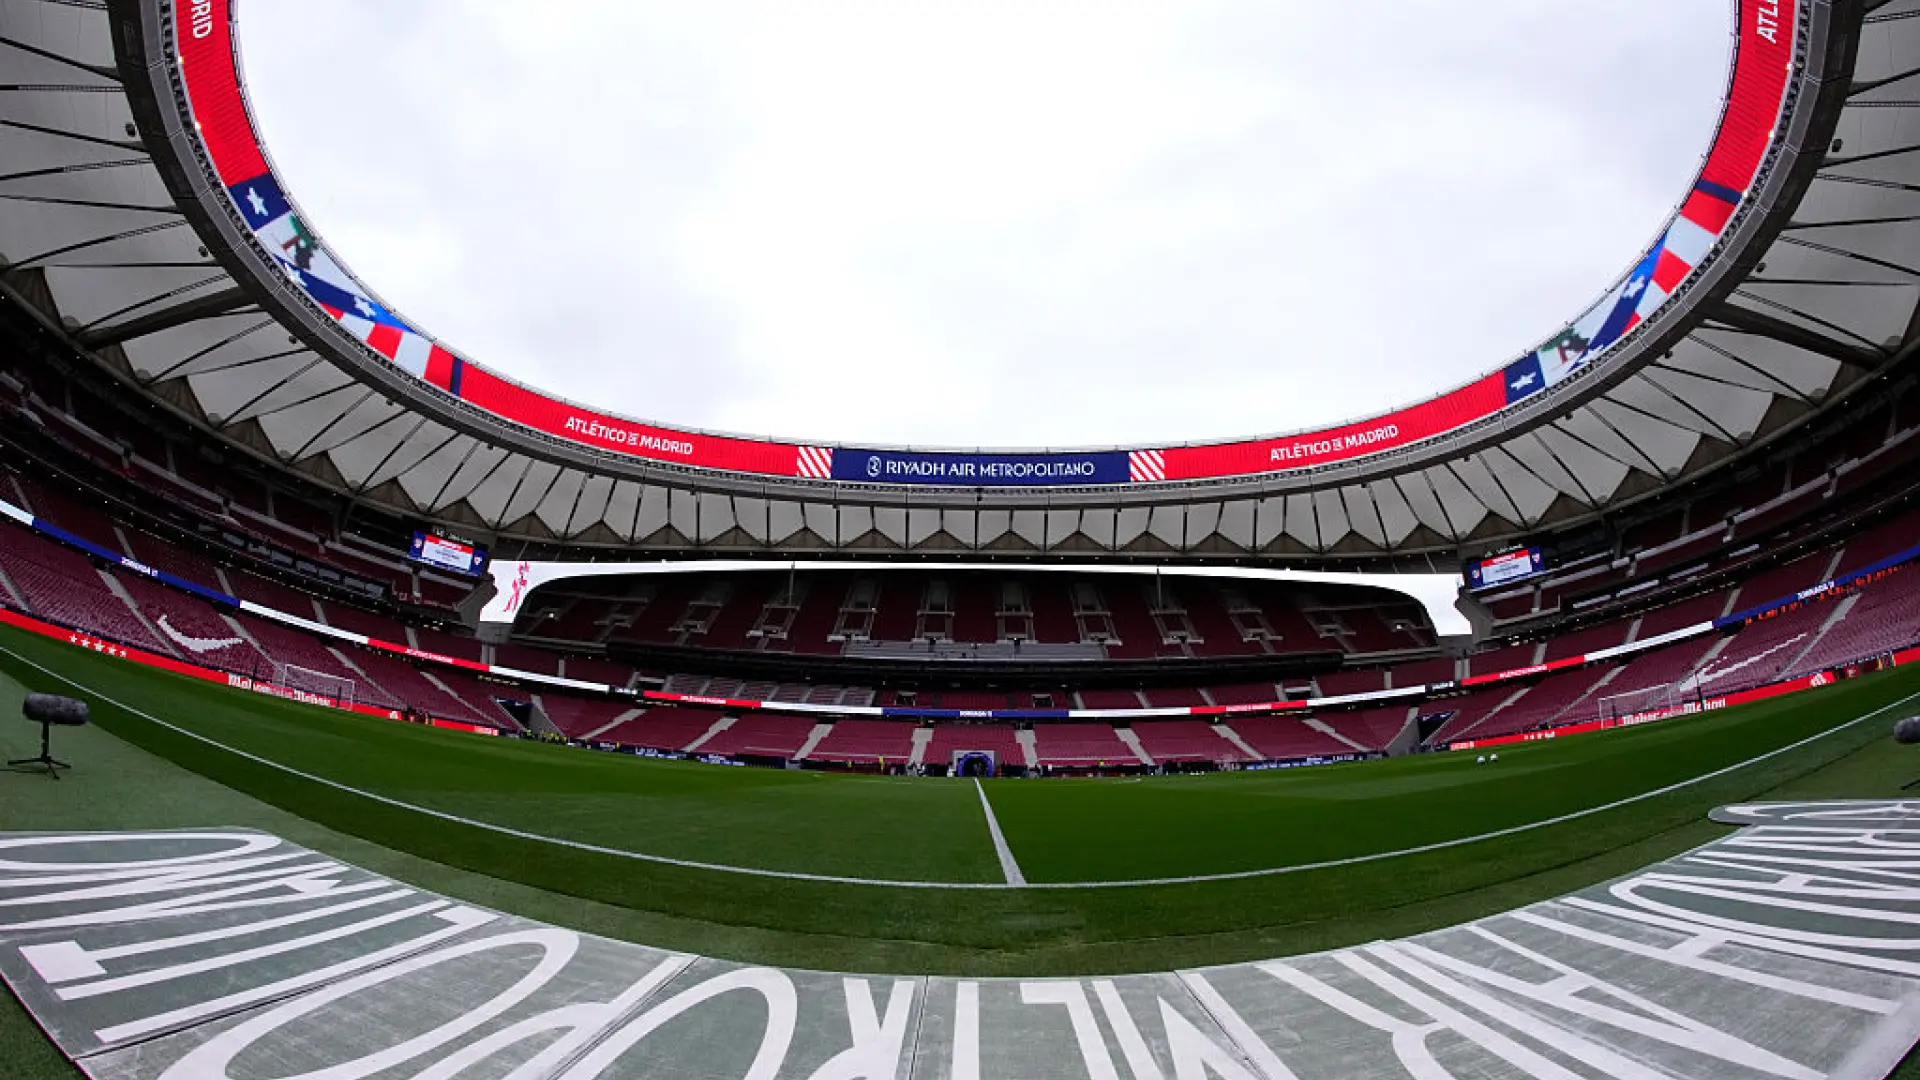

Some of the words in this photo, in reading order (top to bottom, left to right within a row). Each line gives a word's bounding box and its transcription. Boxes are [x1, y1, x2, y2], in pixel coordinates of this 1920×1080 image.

[191, 0, 212, 38] RID
[564, 416, 627, 443] ATLÉTICO
[639, 435, 693, 455] MADRID
[1270, 440, 1331, 462] ATLÉTICO
[1345, 424, 1399, 449] MADRID
[886, 460, 945, 476] RIYADH
[948, 461, 976, 477] AIR
[980, 461, 1095, 478] METROPOLITANO
